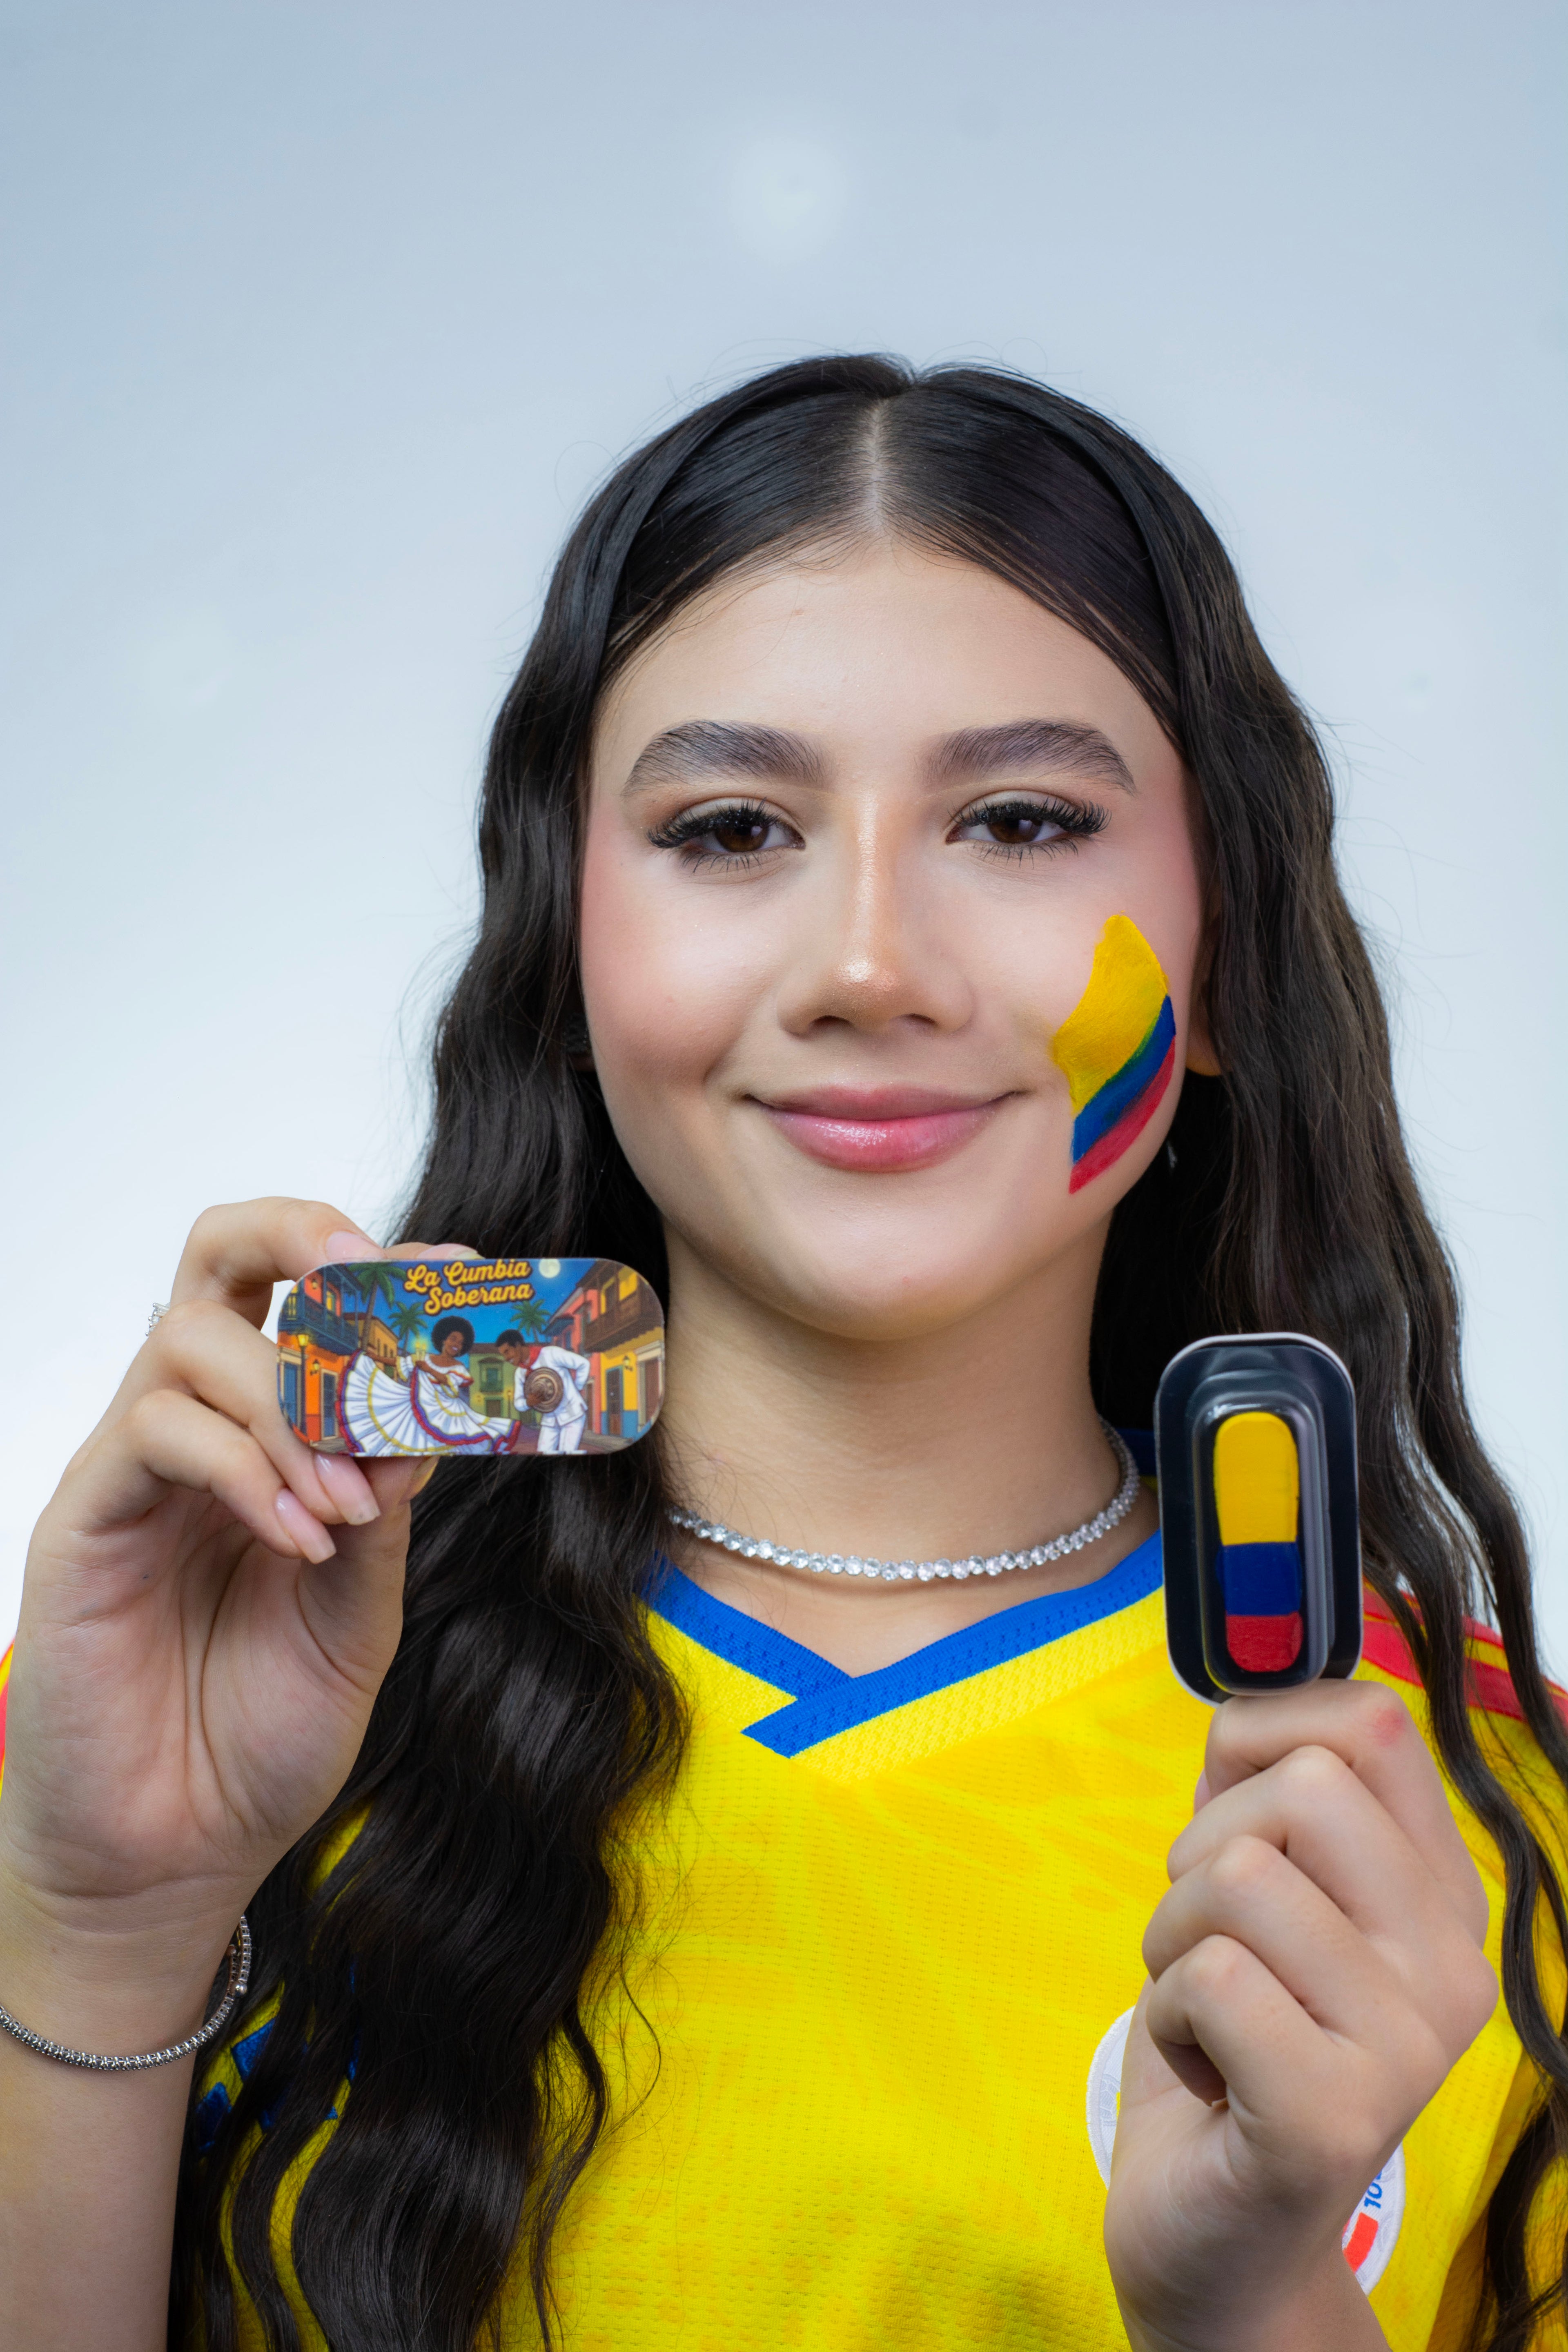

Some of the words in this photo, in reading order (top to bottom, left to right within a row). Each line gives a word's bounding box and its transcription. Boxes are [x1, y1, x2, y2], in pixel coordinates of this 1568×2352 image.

[404, 1264, 441, 1293] La
[443, 1259, 532, 1286] Cumbia
[424, 1283, 535, 1315] Soberana
[1364, 2171, 1383, 2209] 10
